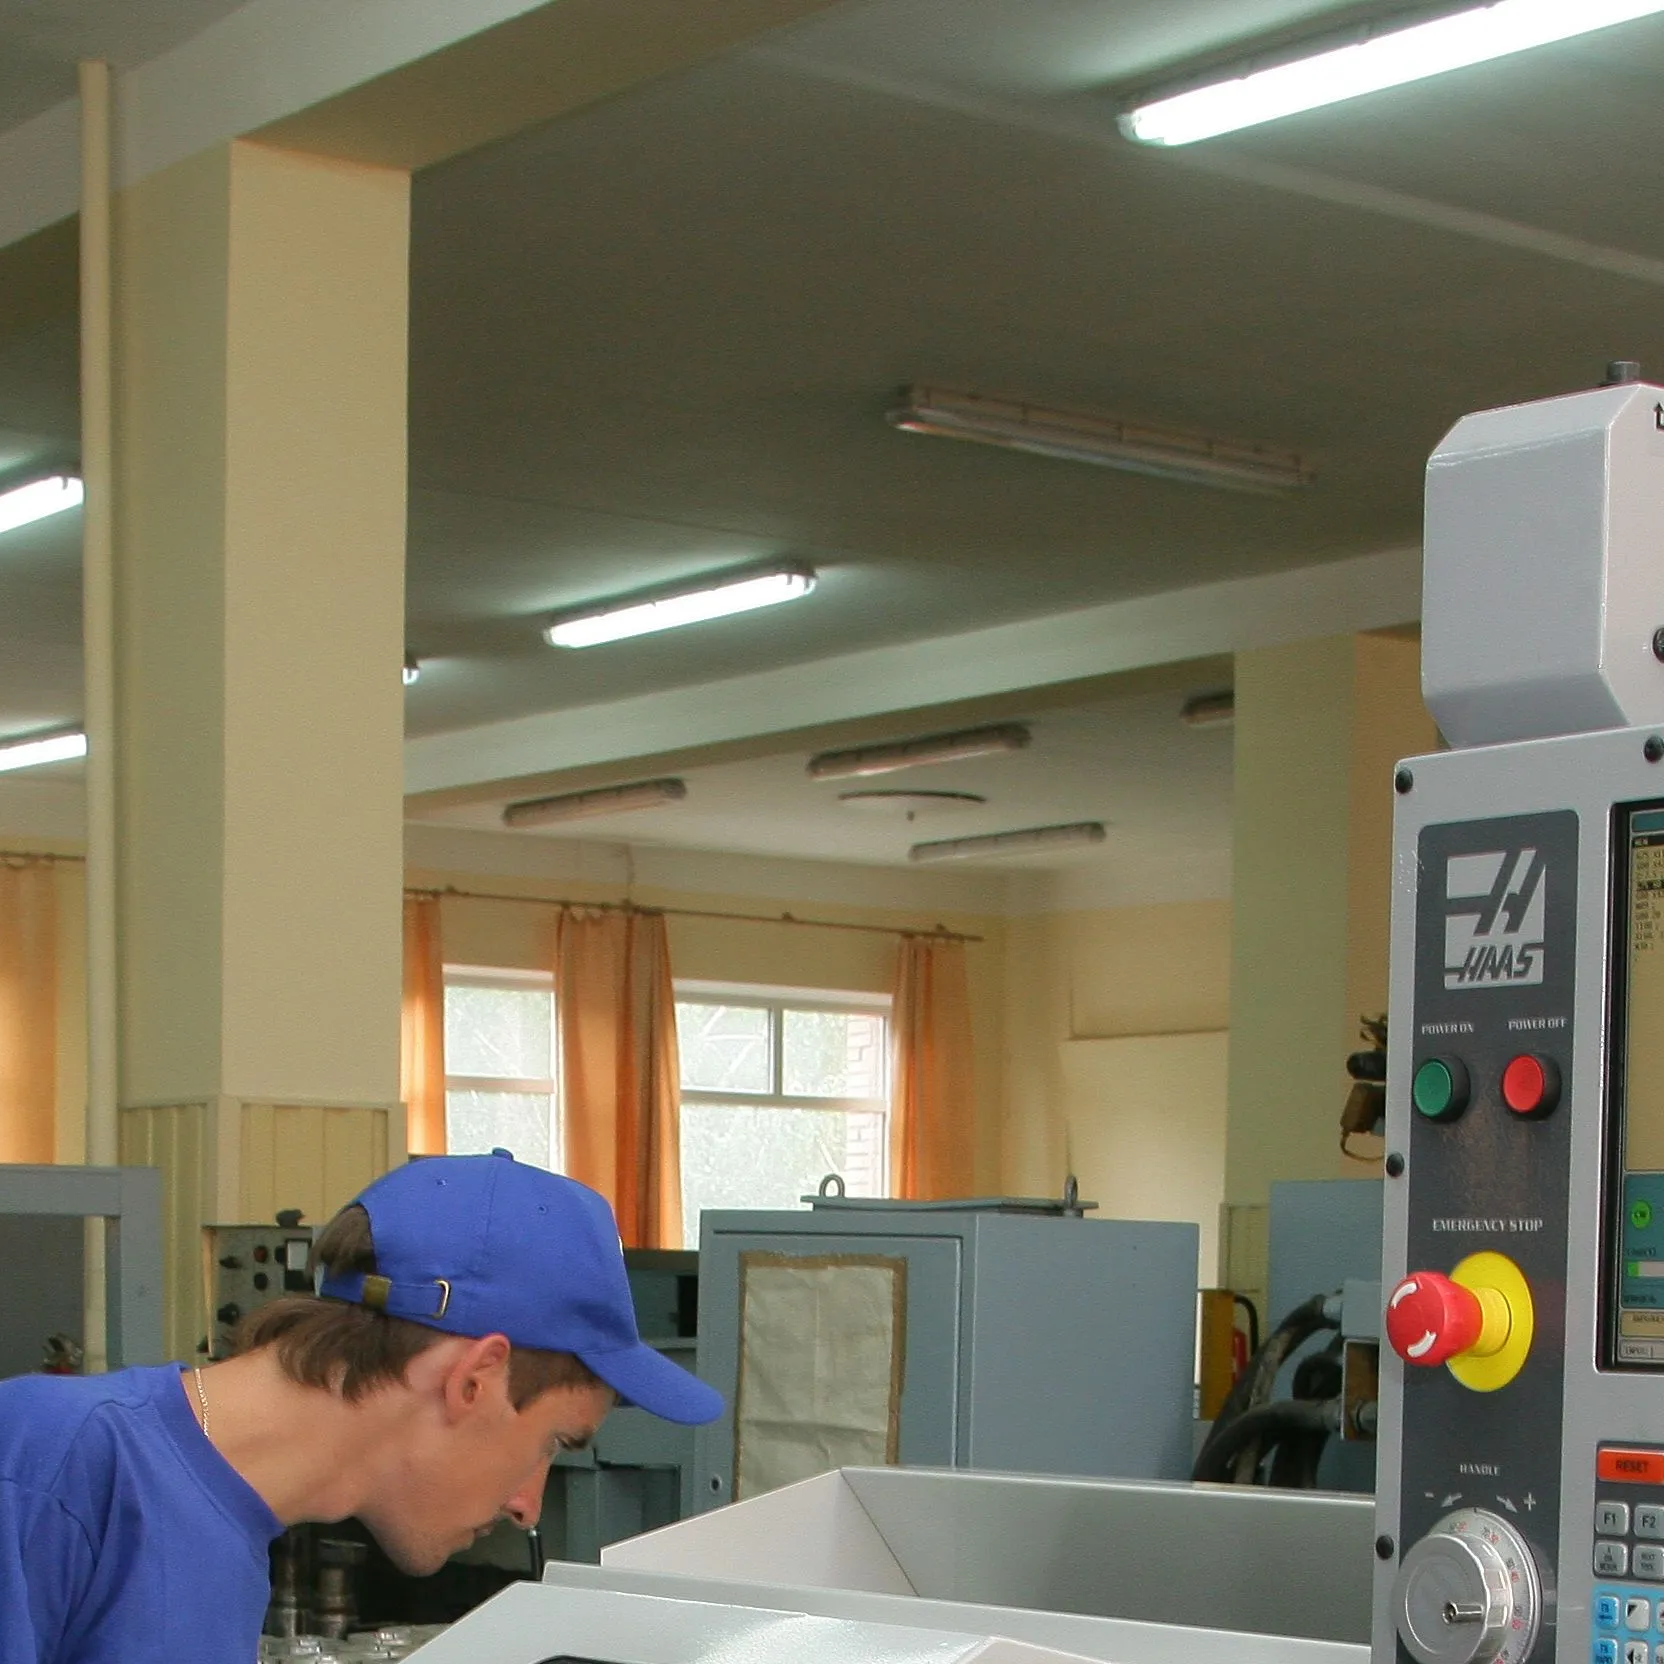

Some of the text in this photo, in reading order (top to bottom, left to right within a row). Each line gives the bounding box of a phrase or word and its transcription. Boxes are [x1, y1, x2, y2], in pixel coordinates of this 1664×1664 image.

[1444, 942, 1544, 983] HAAS
[1422, 1023, 1458, 1034] POWER
[1508, 1018, 1568, 1030] POWER OFF
[1432, 1219, 1543, 1232] EMERGENCY STOP
[1459, 1464, 1500, 1476] HANDLE
[1616, 1460, 1648, 1472] RESET
[1604, 1512, 1616, 1524] F1
[1642, 1515, 1656, 1528] F2
